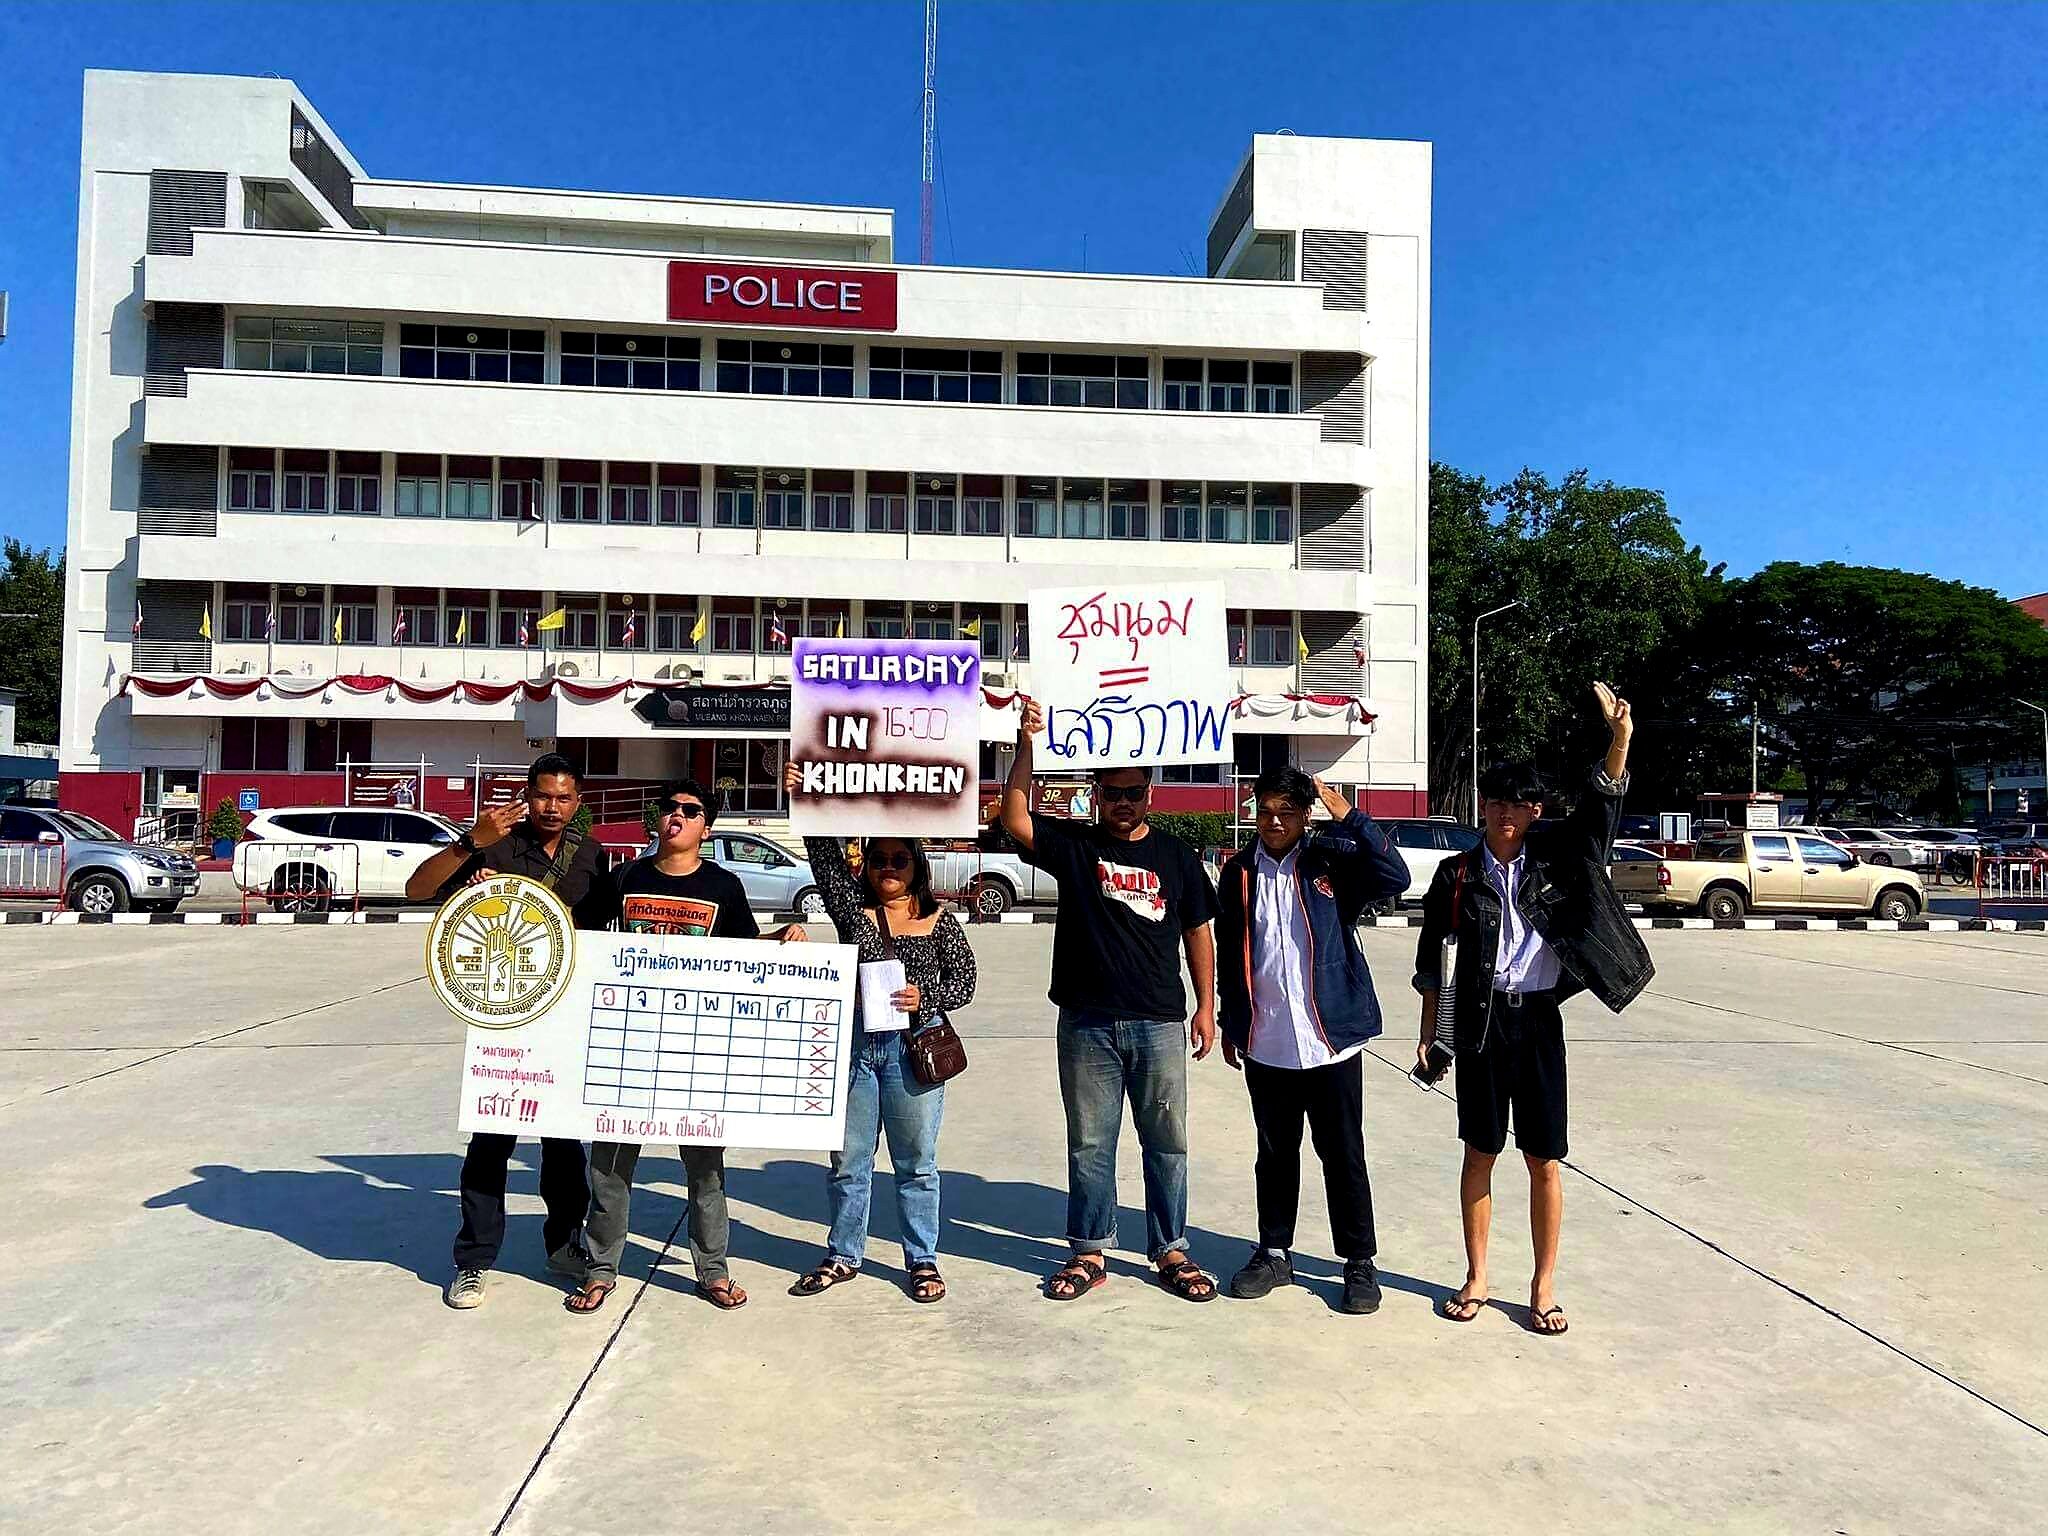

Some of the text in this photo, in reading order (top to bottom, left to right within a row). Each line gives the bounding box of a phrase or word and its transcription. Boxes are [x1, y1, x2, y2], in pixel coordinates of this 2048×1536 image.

[705, 274, 863, 312] POLICE
[1057, 591, 1193, 664] ชุมนุม
[803, 653, 975, 685] SATURDAY
[827, 706, 948, 750] IN 16:00
[1046, 694, 1231, 758] เสรีภาพ
[803, 760, 965, 794] KHONKAEN
[602, 987, 616, 1006] อ
[636, 990, 647, 1008] จ
[674, 993, 687, 1011] อ
[703, 996, 720, 1012] พ
[775, 1000, 791, 1019] ศ
[814, 1000, 833, 1022] ส
